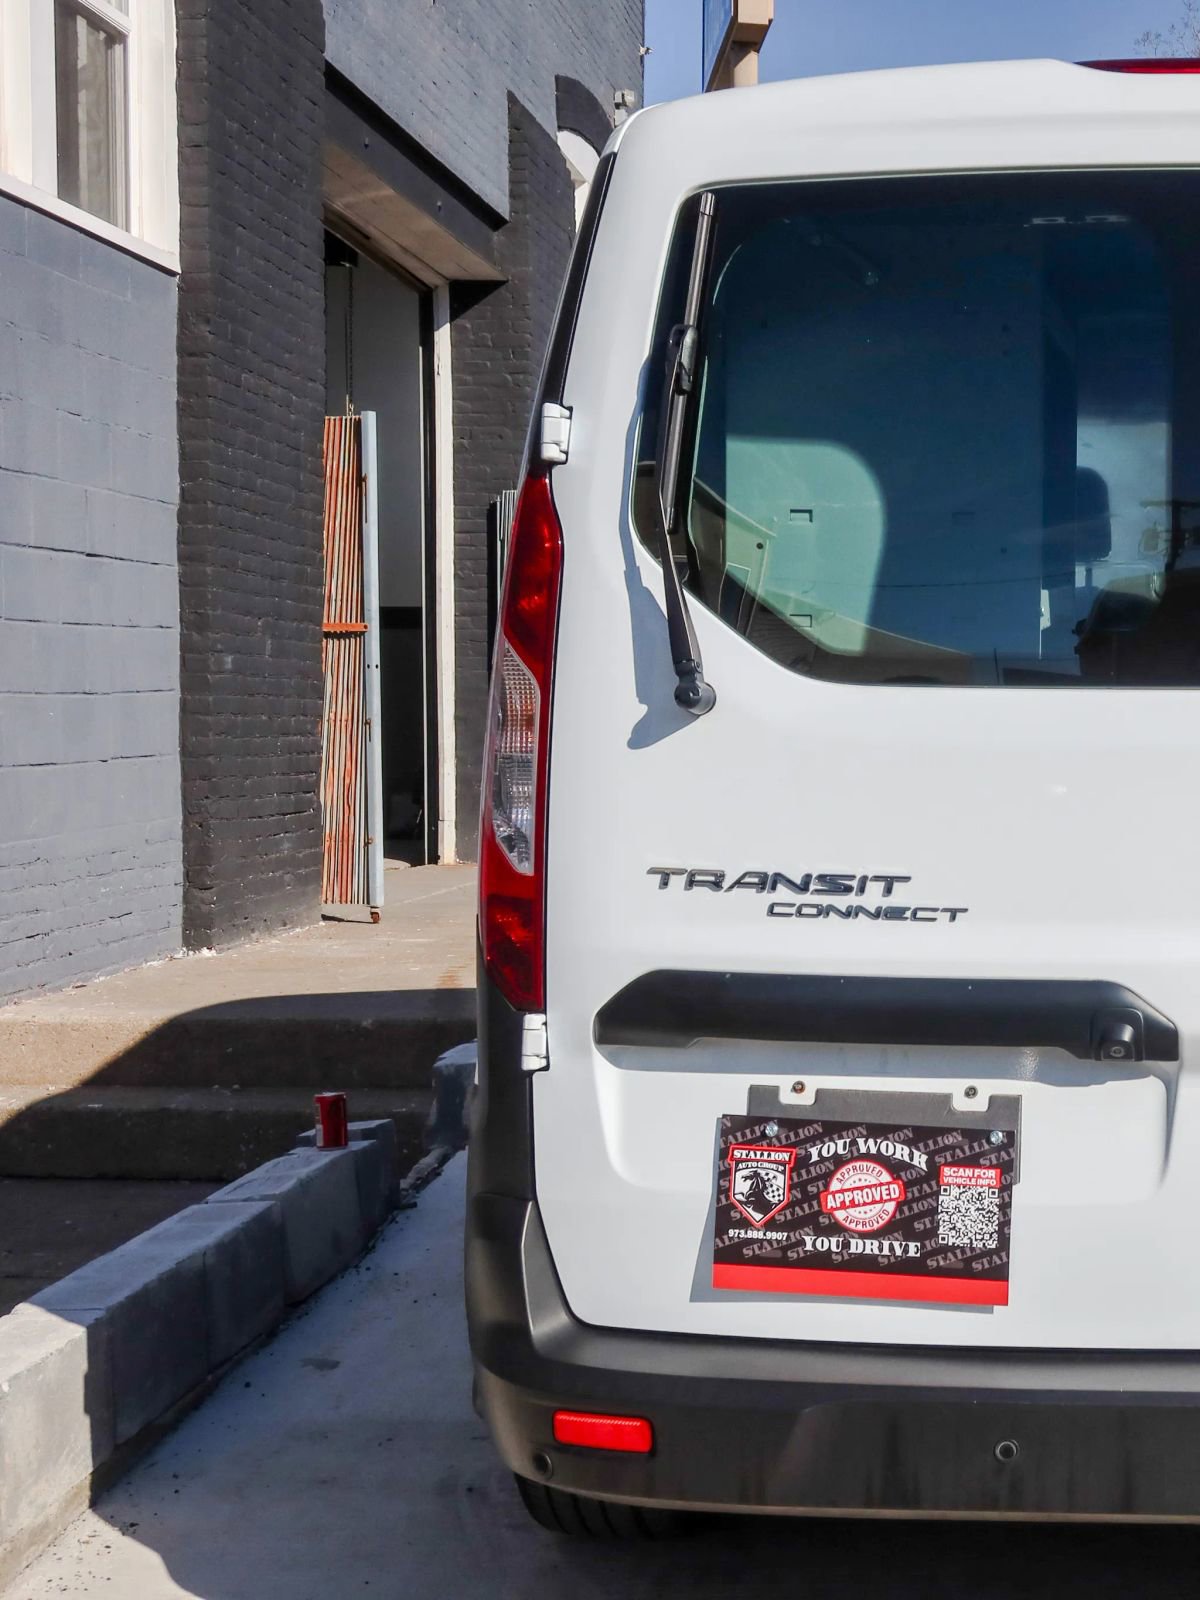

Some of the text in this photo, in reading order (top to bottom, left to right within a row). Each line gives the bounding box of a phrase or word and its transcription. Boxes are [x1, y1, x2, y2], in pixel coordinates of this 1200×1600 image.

[646, 866, 912, 898] TRANSIT
[766, 902, 969, 923] CONNECT
[733, 1149, 791, 1161] STALLION
[808, 1138, 851, 1164] YOU
[856, 1137, 928, 1172] WORK
[737, 1161, 757, 1170] AUTO
[836, 1163, 883, 1184] APPROVED
[943, 1167, 973, 1177] SCAN
[974, 1169, 996, 1179] FOR
[943, 1177, 996, 1186] VEHICLE INFO
[826, 1183, 900, 1210] APPROVED
[843, 1209, 890, 1229] APPROVED
[728, 1229, 788, 1240] 973.888.9907
[802, 1235, 844, 1252] YOU
[848, 1238, 921, 1258] DRIVE
